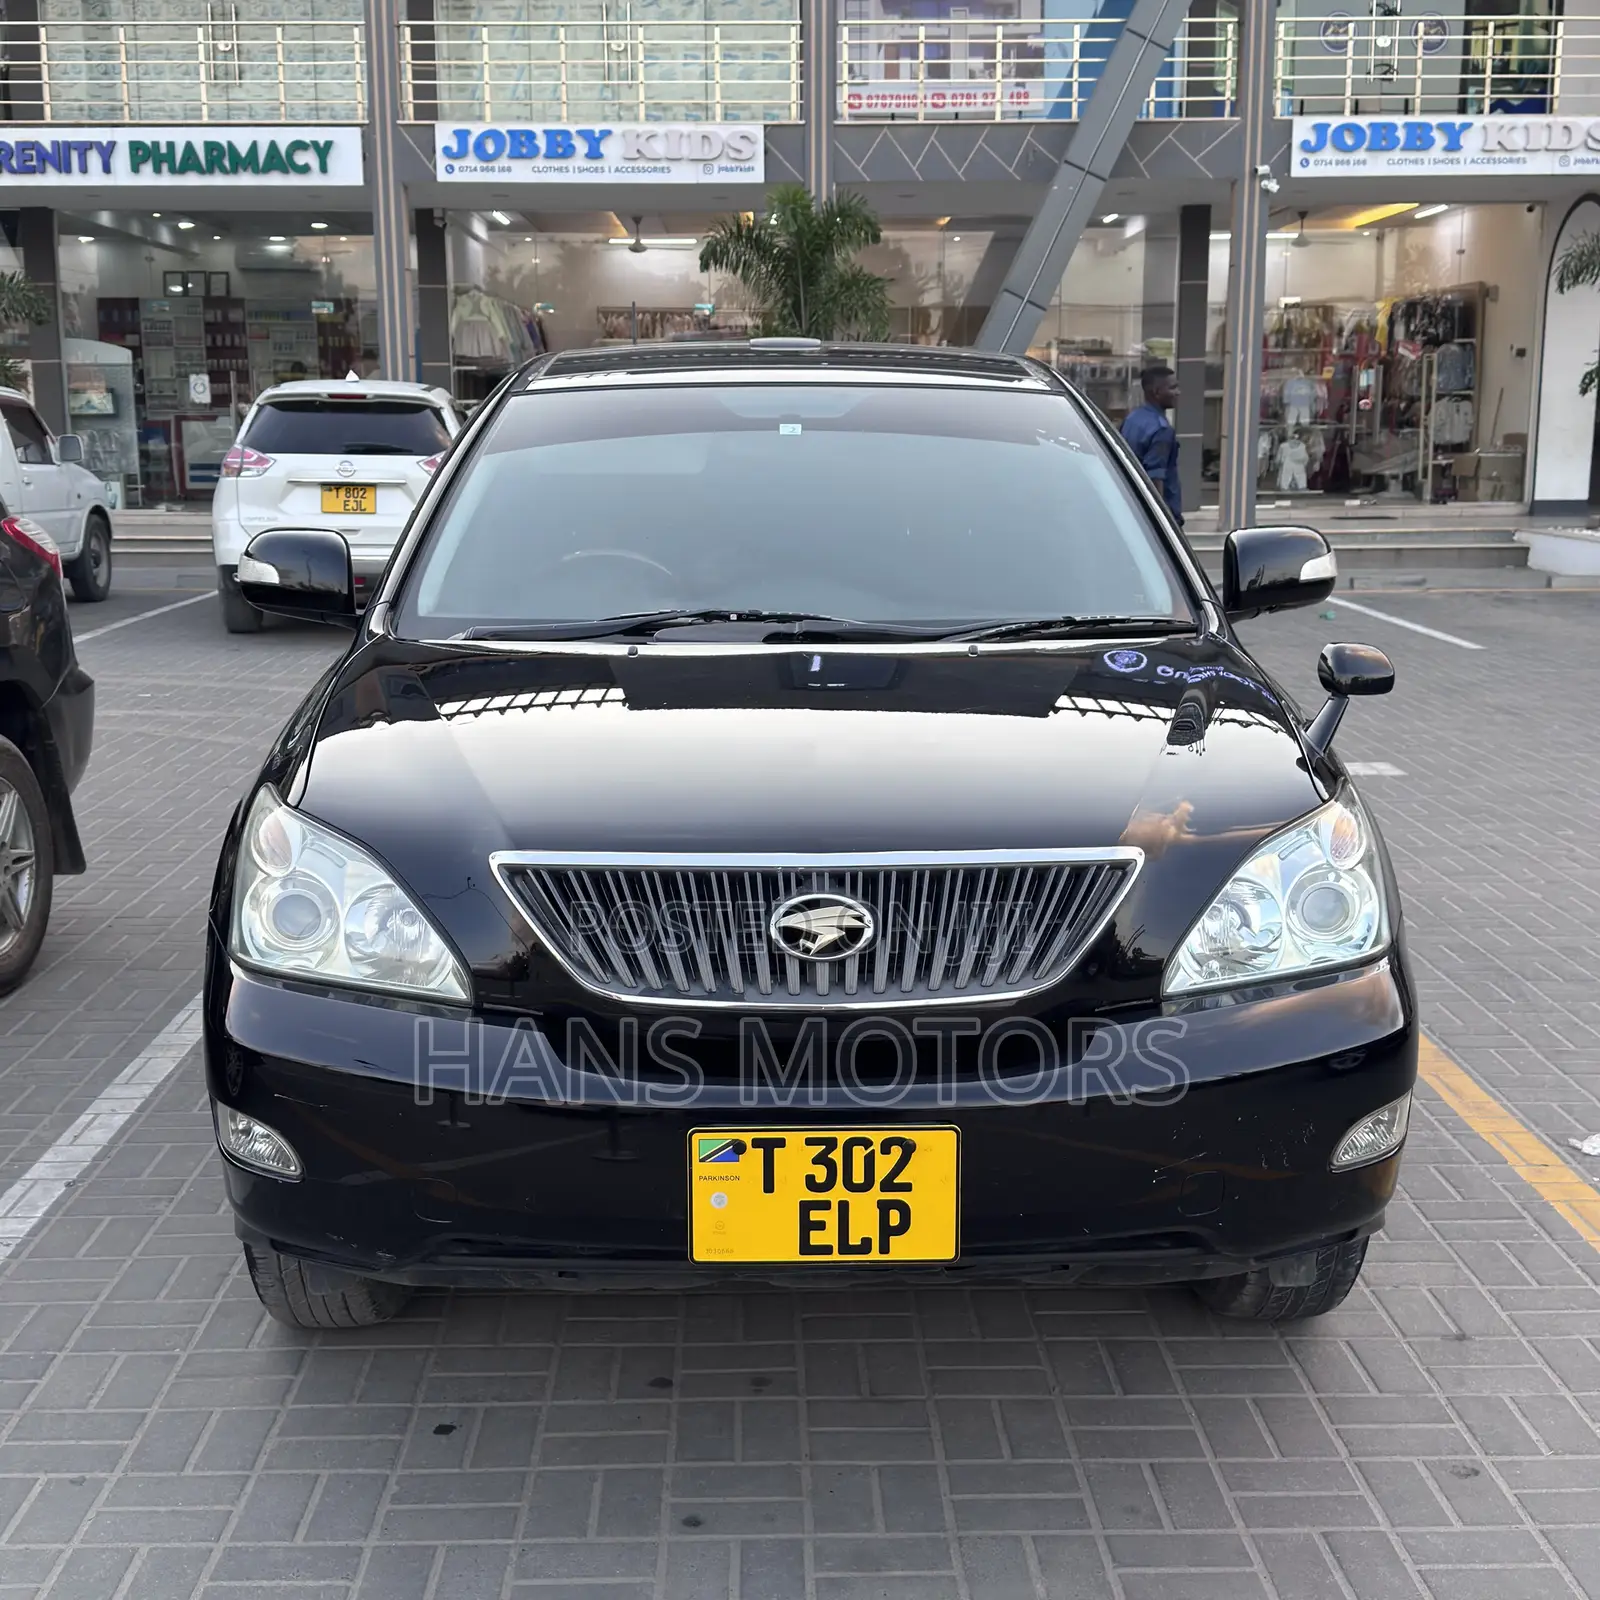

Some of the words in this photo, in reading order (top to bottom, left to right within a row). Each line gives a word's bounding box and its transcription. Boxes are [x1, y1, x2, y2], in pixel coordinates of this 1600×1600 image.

[441, 128, 613, 162] JOBBY
[621, 129, 759, 162] KIDS
[1300, 121, 1474, 153] JOBBY
[0, 140, 117, 174] RENITY
[128, 139, 334, 175] PHARMACY
[1387, 157, 1425, 166] CLOTHES
[1432, 157, 1461, 165] SHOES
[1470, 156, 1528, 165] ACCESSORIES
[532, 165, 570, 174] CLOTHES
[577, 165, 605, 174] SHOES
[614, 165, 672, 174] ACCESSORIES
[333, 486, 342, 499] T
[344, 487, 367, 499] 802
[343, 499, 367, 511] EJL
[751, 1137, 787, 1194] T
[804, 1136, 914, 1194] 302
[698, 1174, 741, 1182] PARKINSON
[798, 1198, 912, 1256] ELP
